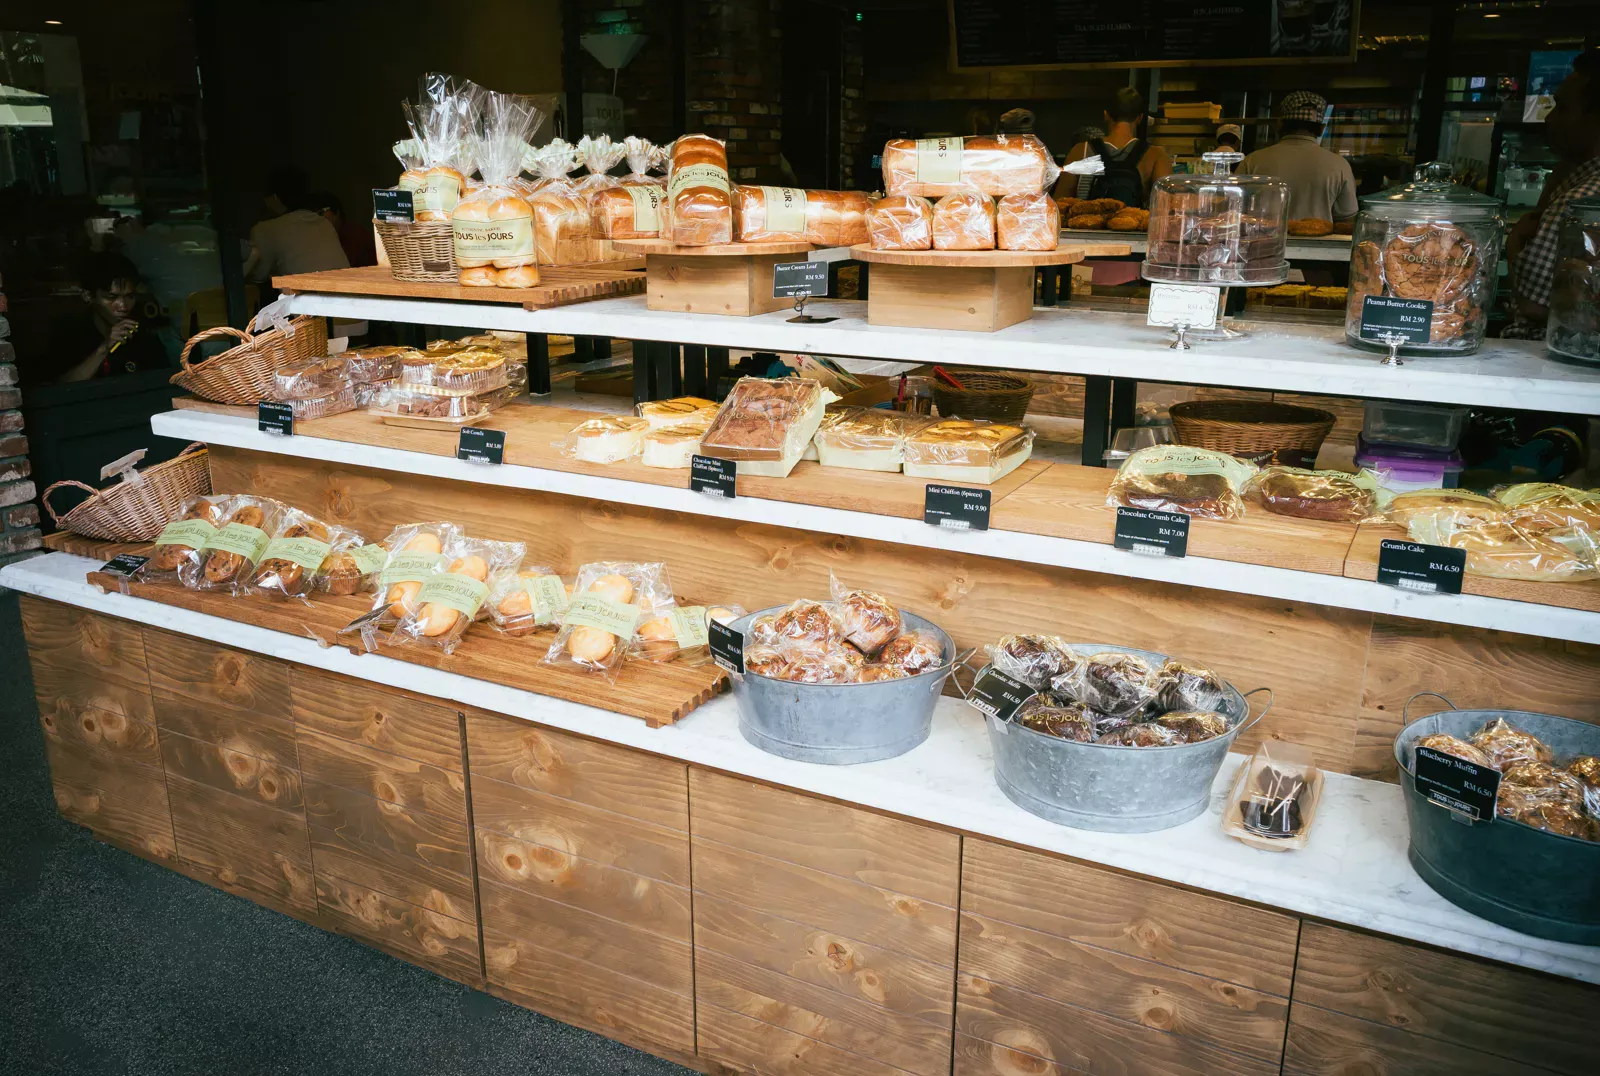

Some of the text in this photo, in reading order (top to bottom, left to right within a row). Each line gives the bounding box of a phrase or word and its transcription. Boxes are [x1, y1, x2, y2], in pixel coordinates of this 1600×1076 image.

[597, 108, 620, 120] TOUS
[455, 232, 474, 240] TOUS
[487, 232, 514, 242] JOURS
[1402, 252, 1429, 264] TOUS
[1367, 298, 1386, 306] Peanut
[1405, 302, 1427, 310] Cookie
[1118, 509, 1186, 523] Chocolate Crumb Cake
[1382, 542, 1425, 553] Crumb Cake
[1429, 562, 1443, 570] RM
[1010, 694, 1021, 704] 6.50
[1046, 713, 1060, 722] les
[1420, 749, 1478, 776] Blueberry Muffin
[1464, 780, 1477, 792] RM
[1477, 786, 1492, 798] 6.50
[1433, 792, 1448, 802] TOUS
[1454, 801, 1471, 811] JOURS
